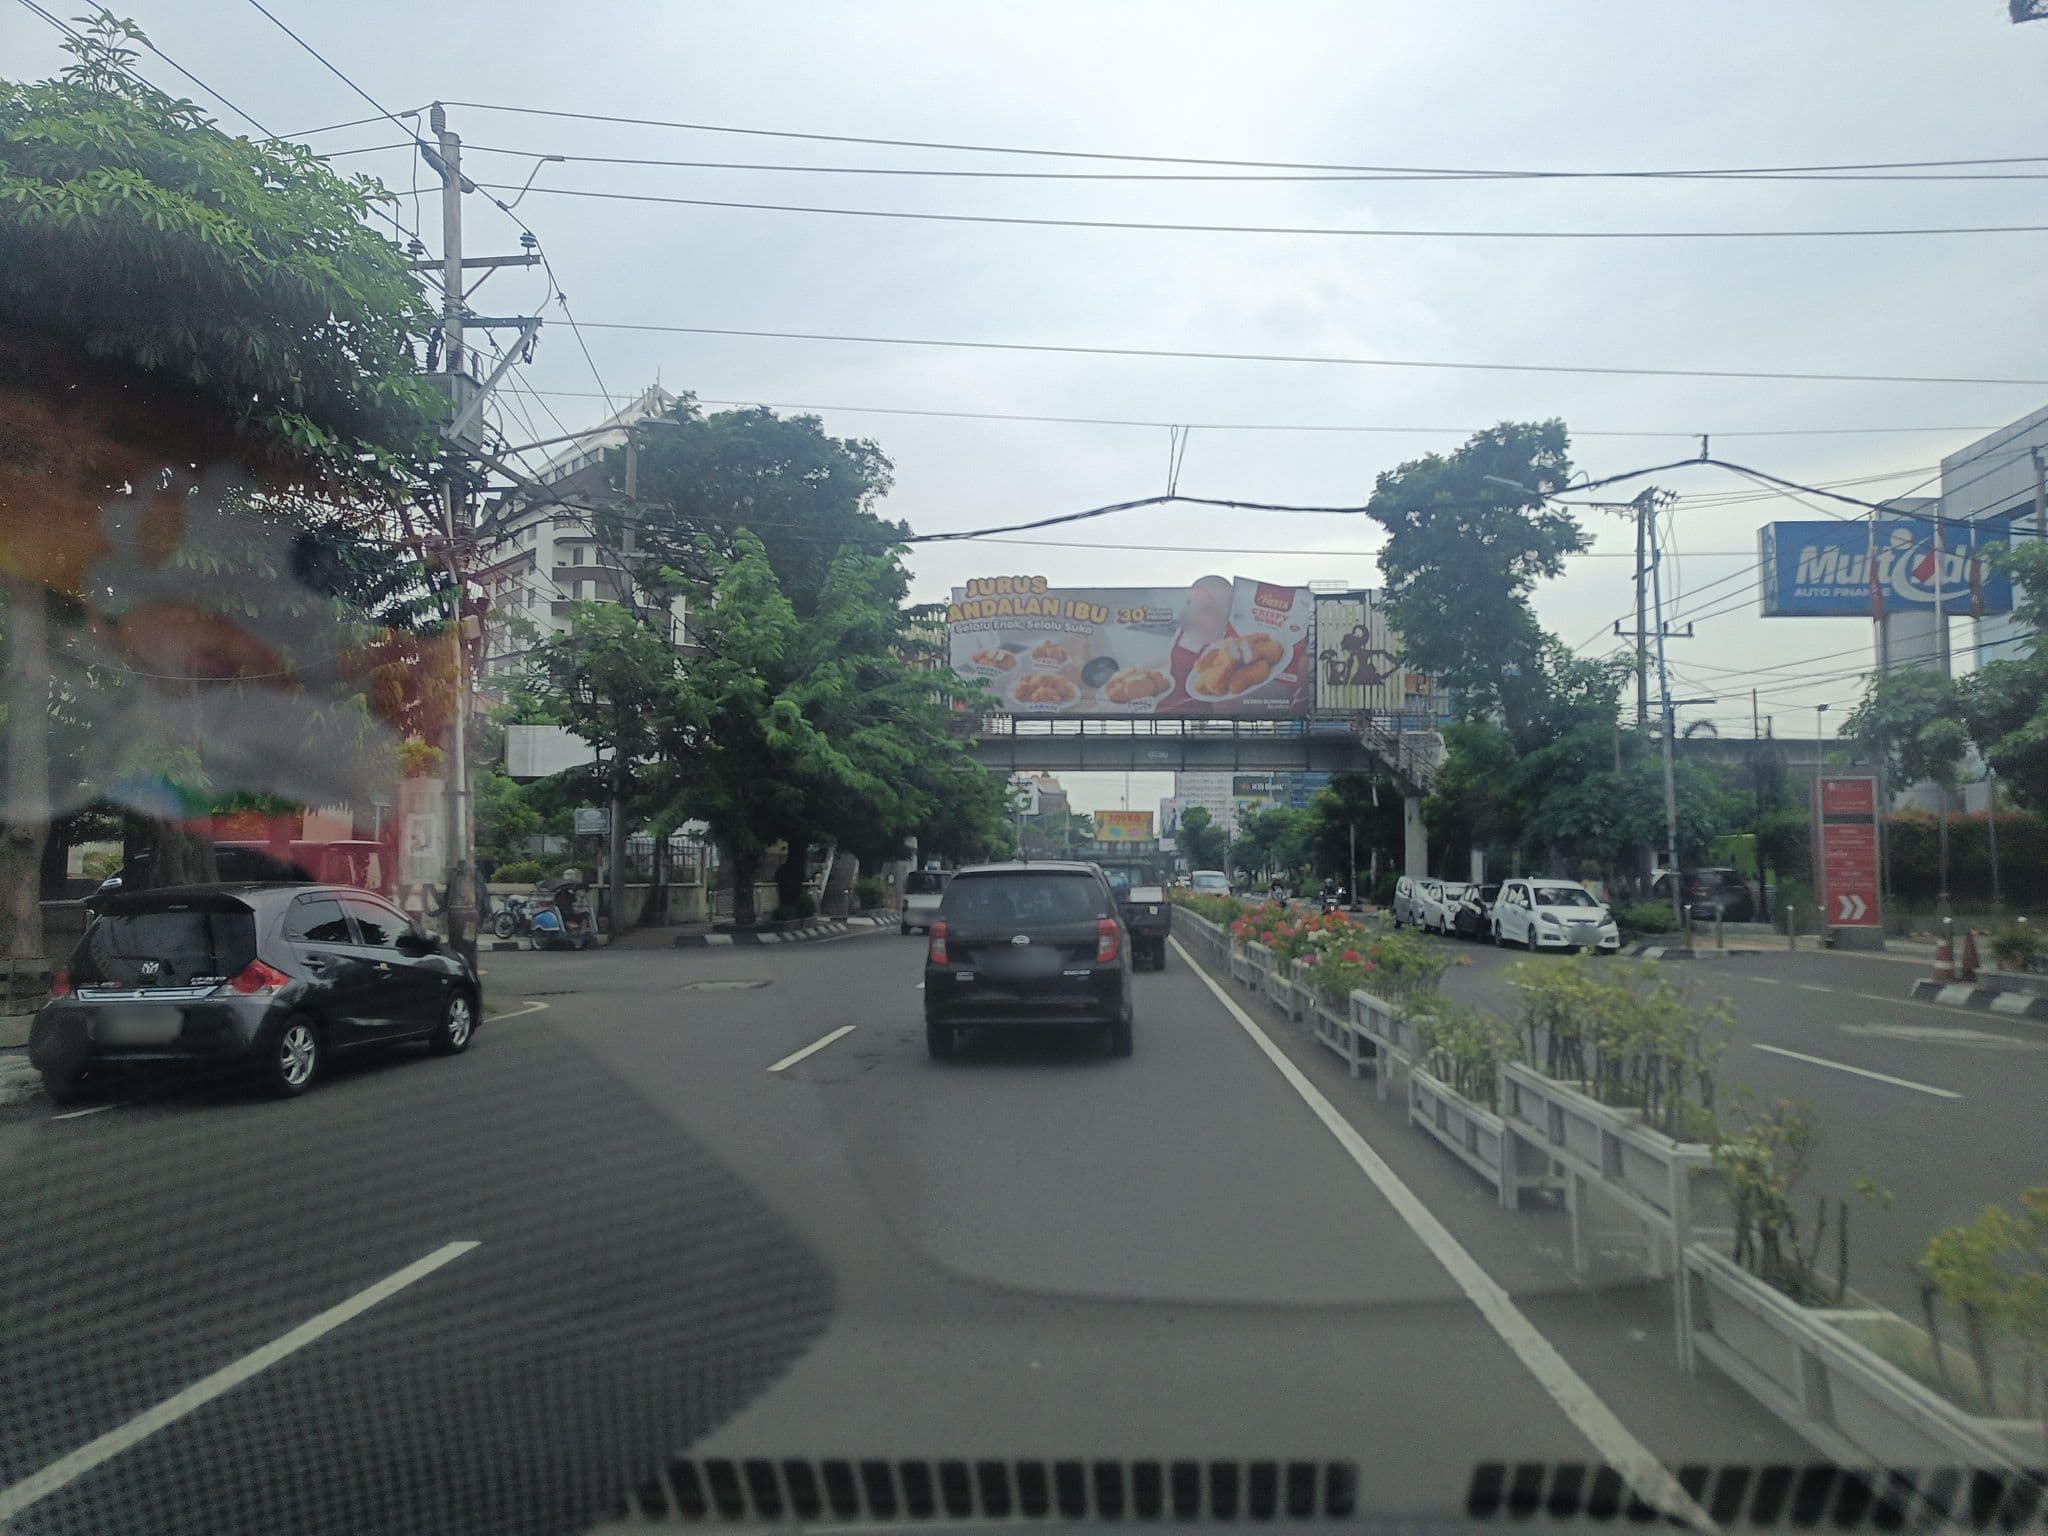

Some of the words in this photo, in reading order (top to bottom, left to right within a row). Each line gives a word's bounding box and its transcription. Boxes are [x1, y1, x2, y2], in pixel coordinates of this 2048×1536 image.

[966, 576, 1048, 597] JURUS
[1795, 588, 1830, 598] AUTO
[948, 598, 1060, 622] ANDALAN
[1065, 600, 1107, 624] IBU
[954, 622, 990, 634] Selalu
[1027, 620, 1062, 631] Selalu
[1063, 622, 1094, 635] Suka
